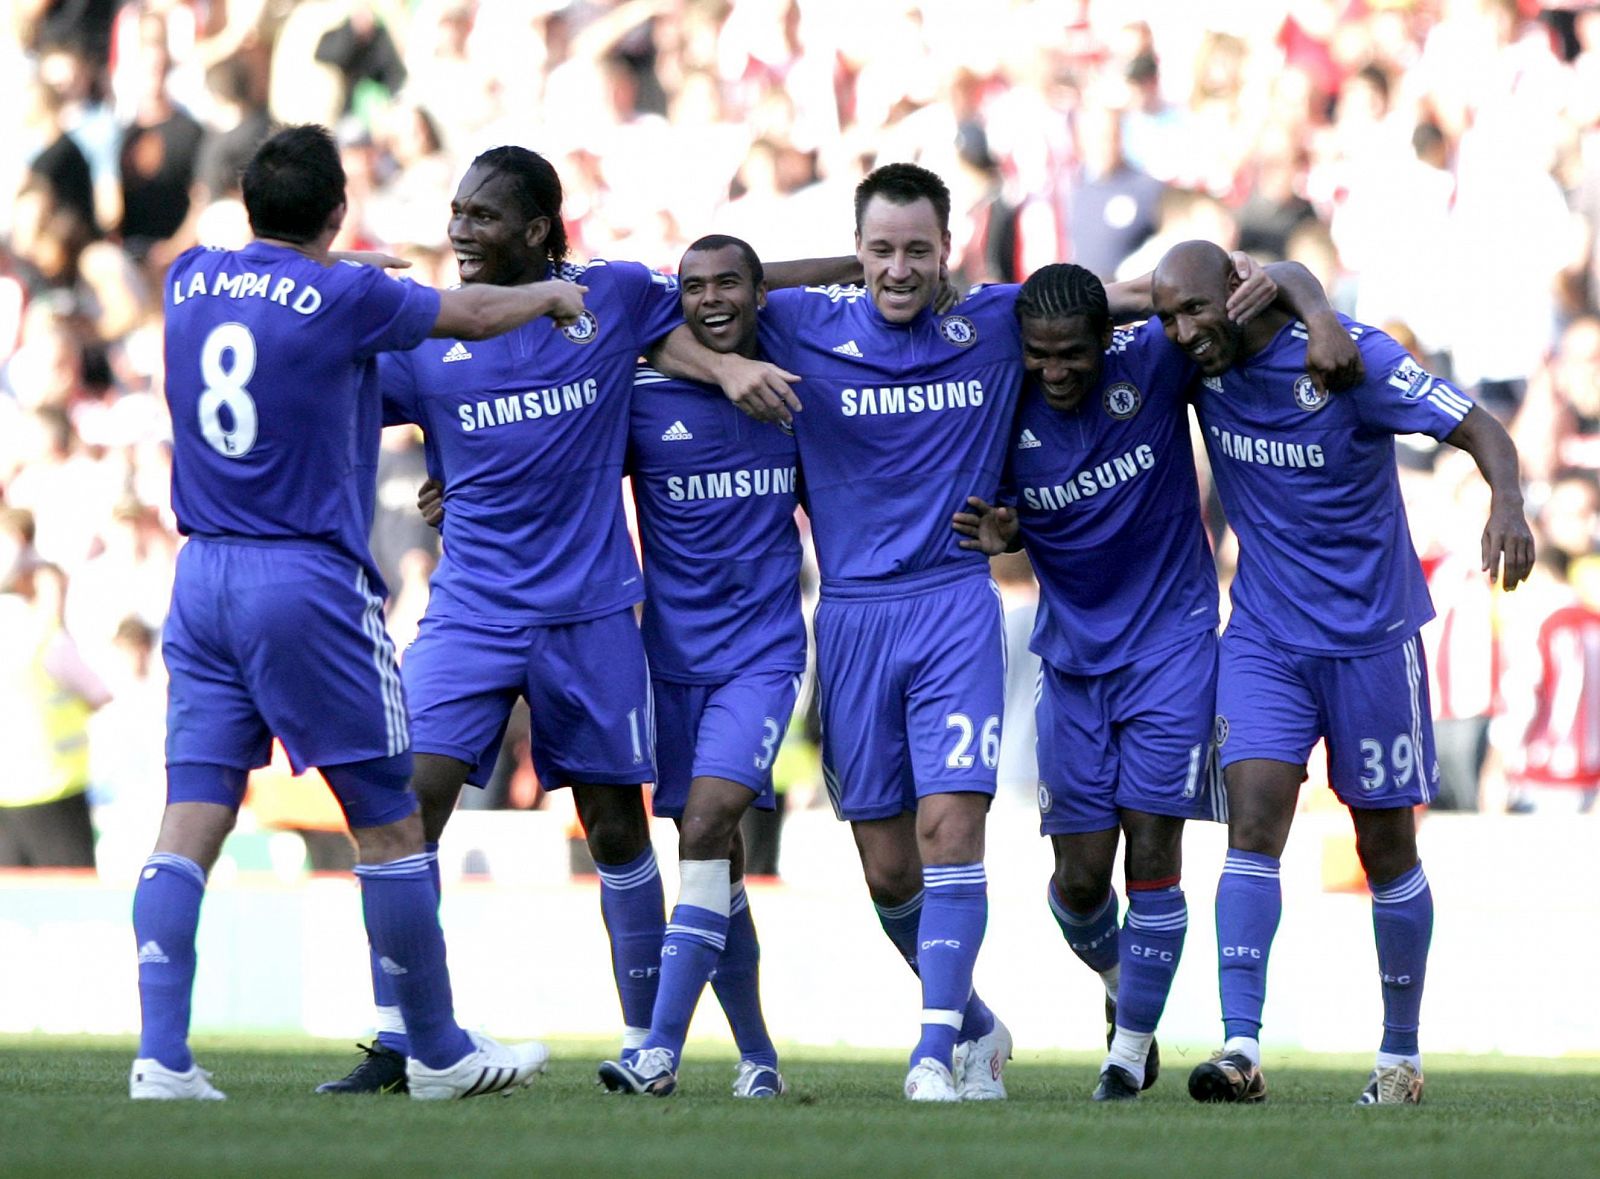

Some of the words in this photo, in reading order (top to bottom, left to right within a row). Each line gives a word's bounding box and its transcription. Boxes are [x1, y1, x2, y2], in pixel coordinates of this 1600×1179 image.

[173, 271, 322, 315] LAMPARD
[198, 321, 258, 458] 8
[458, 378, 597, 432] SAMSUNG
[841, 379, 984, 416] SAMSUNG
[661, 432, 693, 441] adidas
[1023, 444, 1155, 511] SAMSUNG
[753, 715, 779, 770] 3
[945, 712, 1000, 770] 26
[1359, 732, 1414, 790] 39
[629, 966, 662, 979] CF
[1130, 944, 1173, 962] CFC
[1223, 945, 1261, 959] CFC
